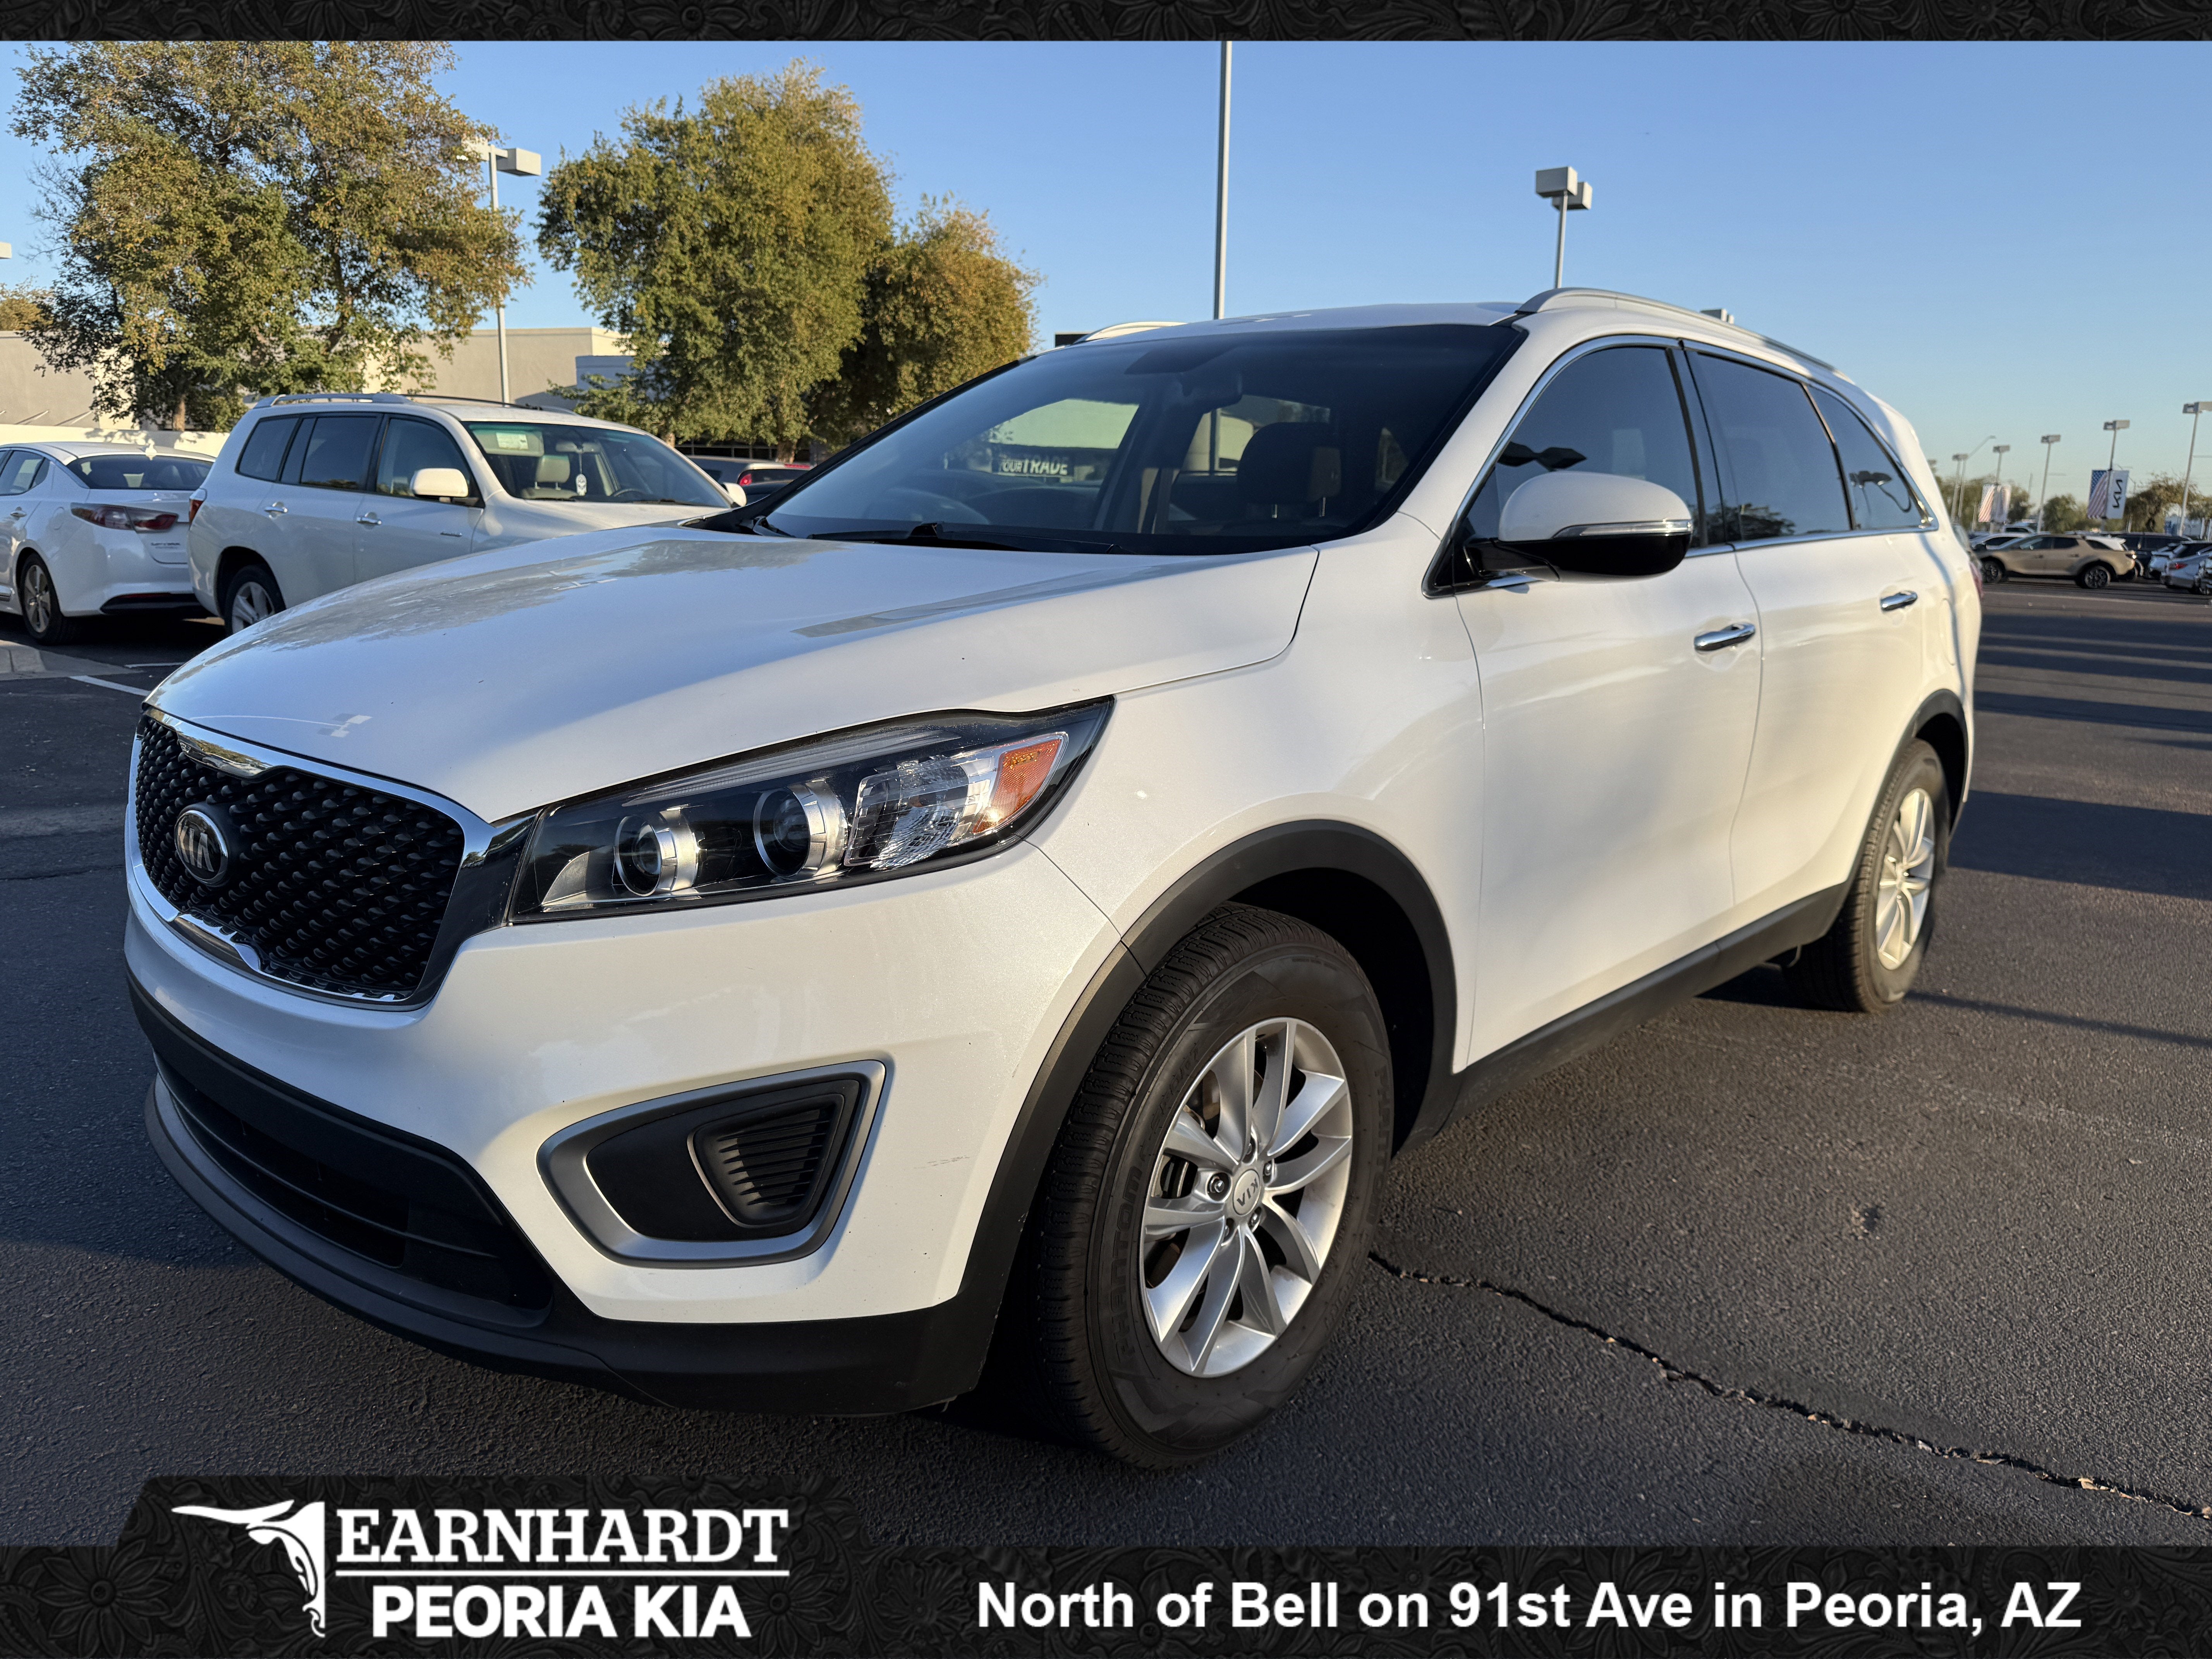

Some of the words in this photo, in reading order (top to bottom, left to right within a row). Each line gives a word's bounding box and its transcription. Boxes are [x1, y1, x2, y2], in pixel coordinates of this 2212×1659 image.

[1024, 454, 1069, 475] TRADE
[2112, 479, 2123, 508] KIA
[177, 816, 215, 872] KIA
[1236, 1177, 1258, 1207] KIA
[1110, 1166, 1142, 1362] PHANTOM
